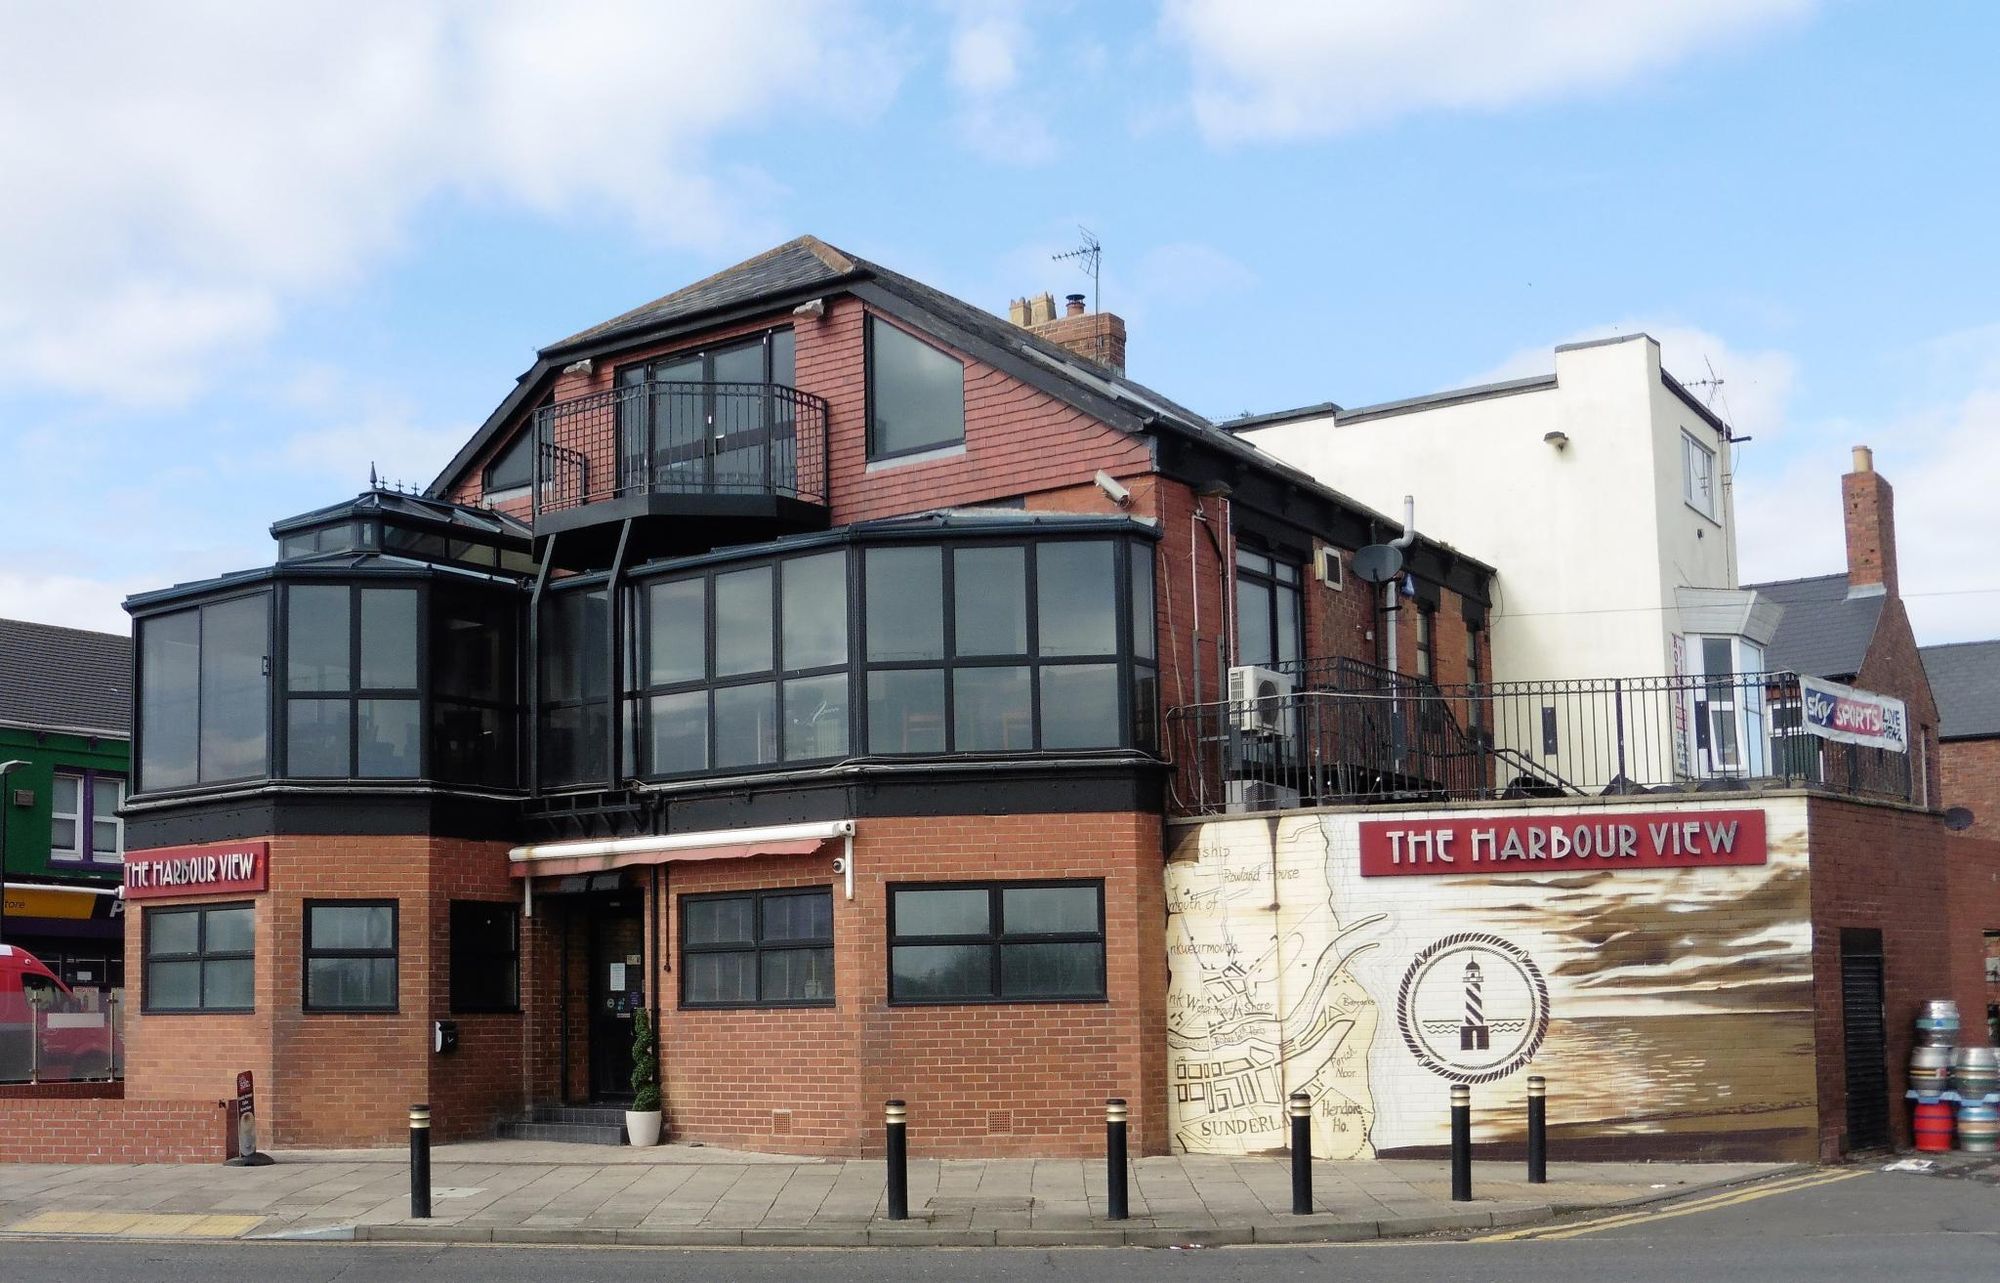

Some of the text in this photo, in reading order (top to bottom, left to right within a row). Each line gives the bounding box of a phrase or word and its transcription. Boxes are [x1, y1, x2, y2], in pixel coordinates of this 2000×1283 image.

[1807, 693, 1880, 731] sky SPORTS
[1386, 820, 1738, 864] THE HARBOUR VIEW
[125, 852, 254, 888] THE HARBOUR VIEW
